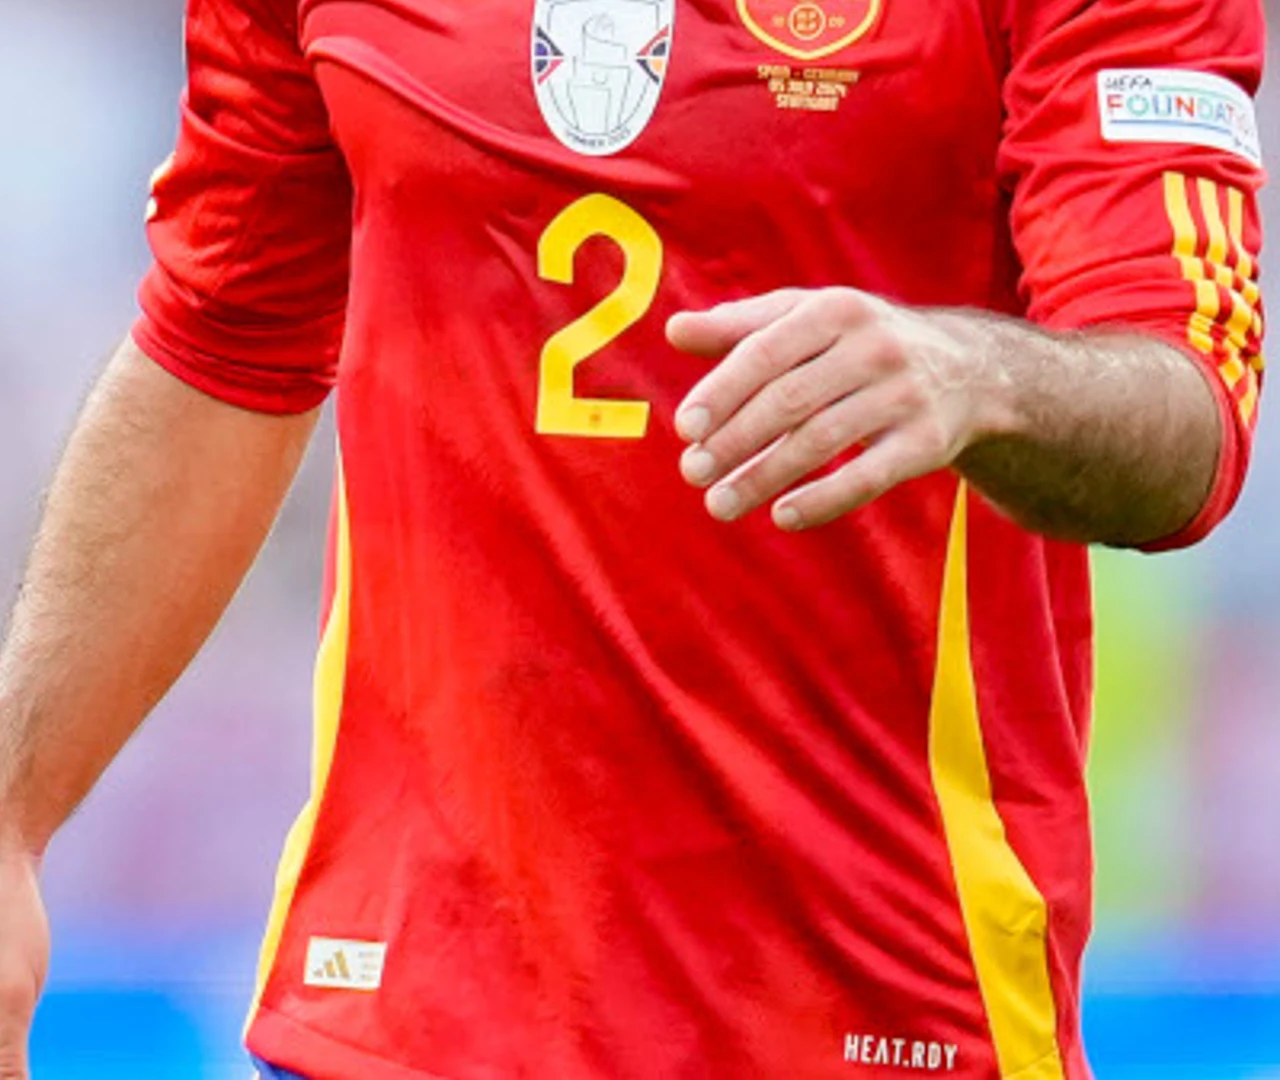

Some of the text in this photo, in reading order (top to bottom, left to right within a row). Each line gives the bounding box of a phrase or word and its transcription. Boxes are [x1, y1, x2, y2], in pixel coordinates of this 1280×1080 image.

[803, 69, 860, 83] GERMANY
[1106, 75, 1152, 90] UEFA
[1106, 94, 1250, 132] FOUNDAT
[535, 192, 663, 438] 2
[844, 1034, 958, 1070] HEAT.RDY
